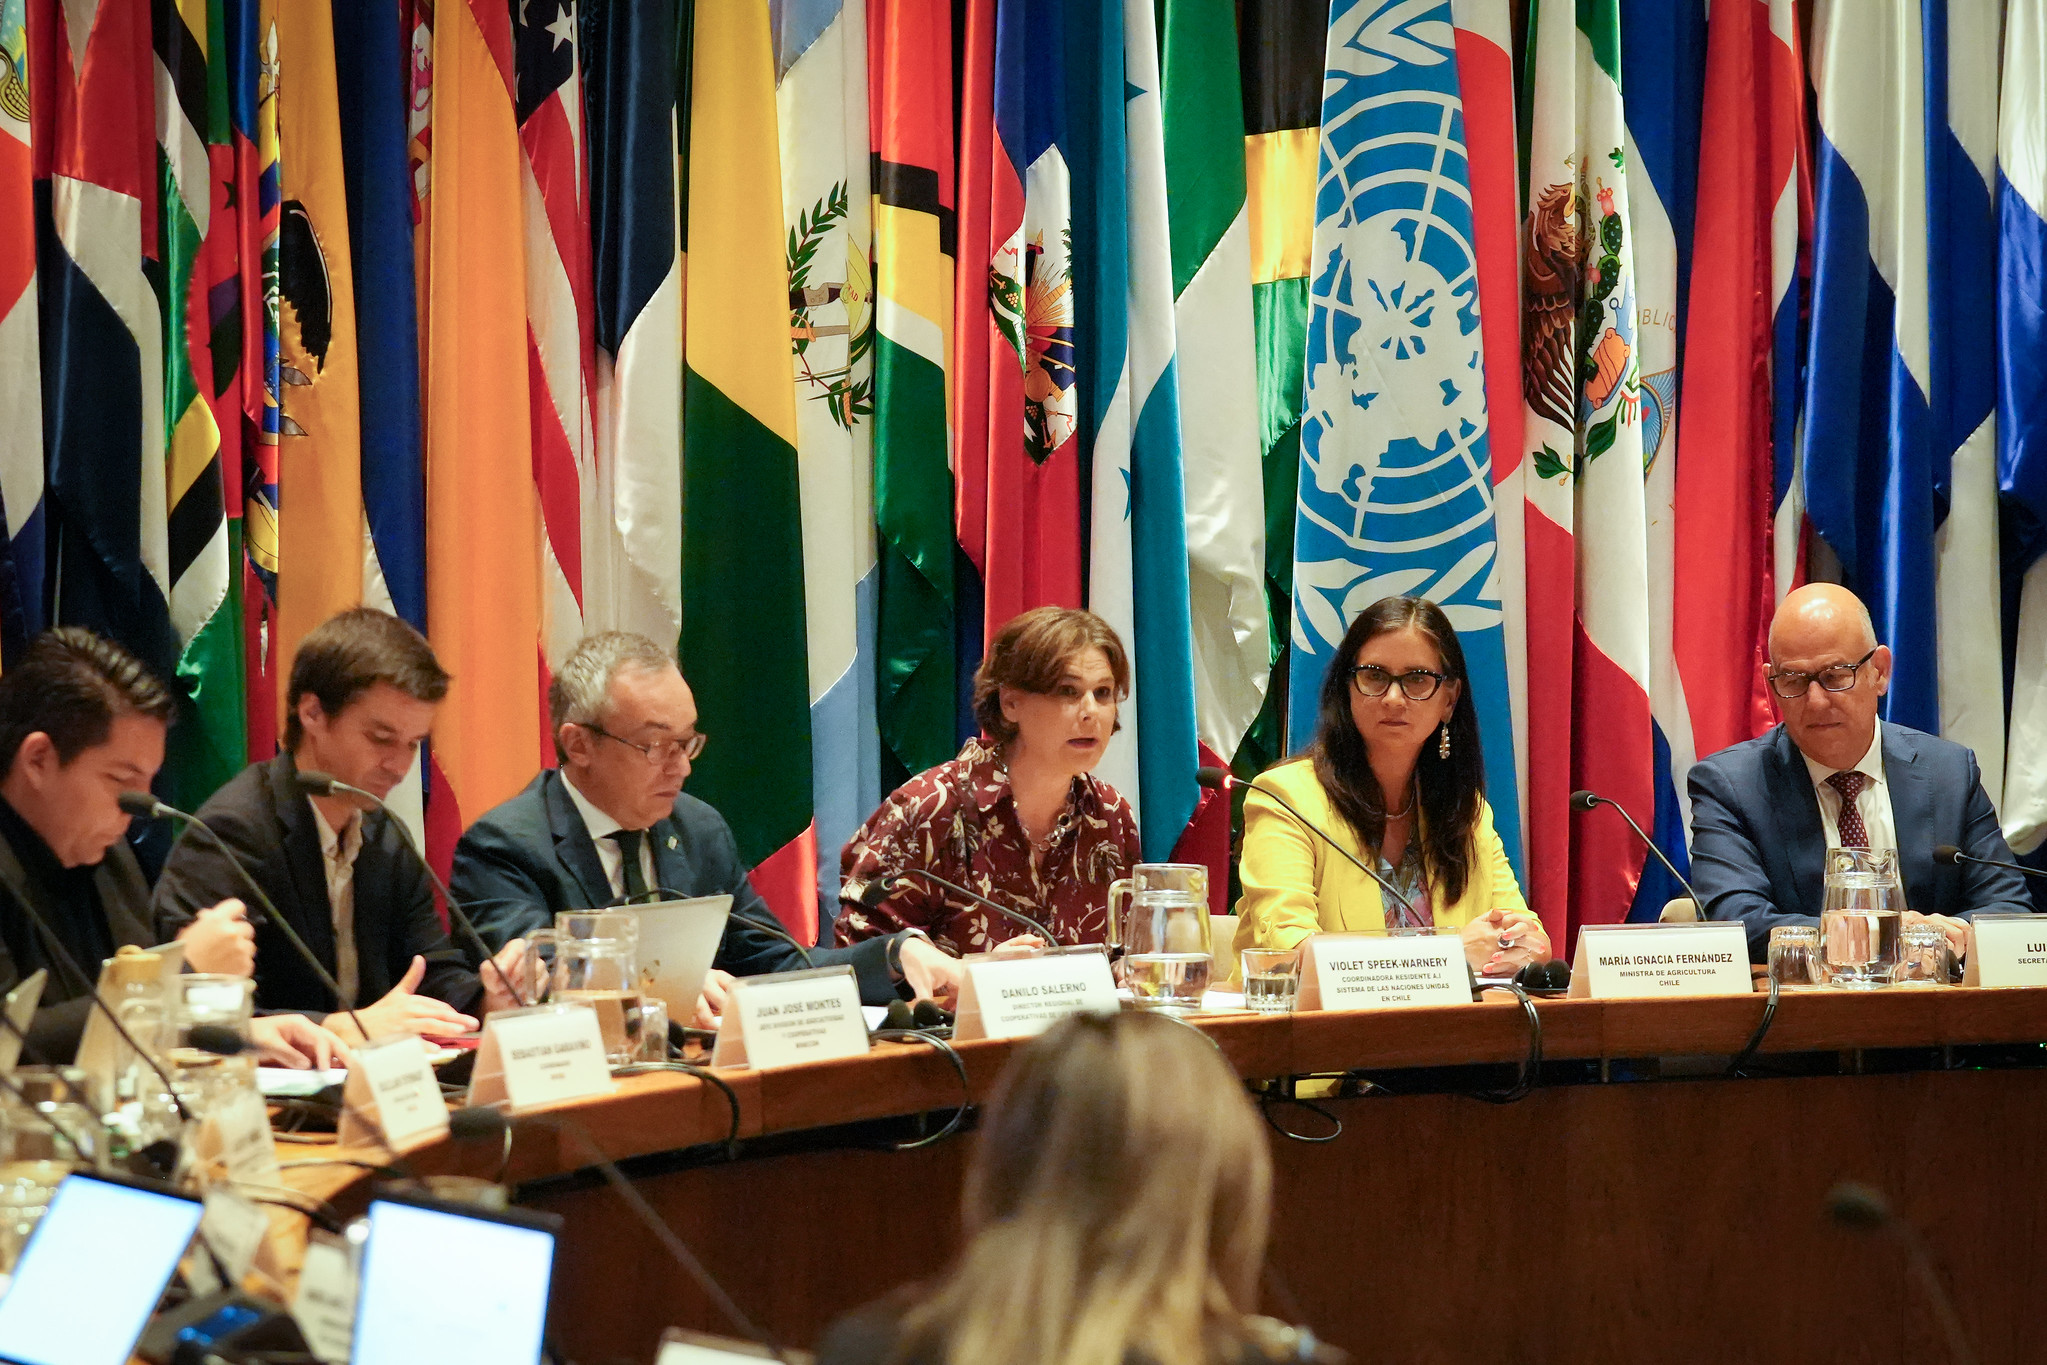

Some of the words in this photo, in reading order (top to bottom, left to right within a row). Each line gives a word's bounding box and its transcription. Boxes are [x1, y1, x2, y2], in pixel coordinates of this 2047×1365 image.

[1329, 960, 1364, 971] VIOLET
[1367, 957, 1448, 970] SPEEK-WARNERY
[1599, 954, 1631, 966] MARÍA
[1633, 955, 1674, 965] IGNACIA
[1676, 952, 1733, 965] FERNÁNDEZ
[1342, 974, 1394, 983] COORDINADORA
[1395, 973, 1431, 981] RESIDENTE
[1666, 968, 1717, 976] AGRICULTURA
[1001, 986, 1039, 999] DANILO
[1041, 982, 1087, 995] SALERNO
[1336, 985, 1365, 994] SISTEMA
[1377, 984, 1390, 992] LAS
[1391, 983, 1425, 991] NACIONES
[1425, 982, 1450, 990] UNIDAS
[1392, 994, 1411, 1002] CHILE
